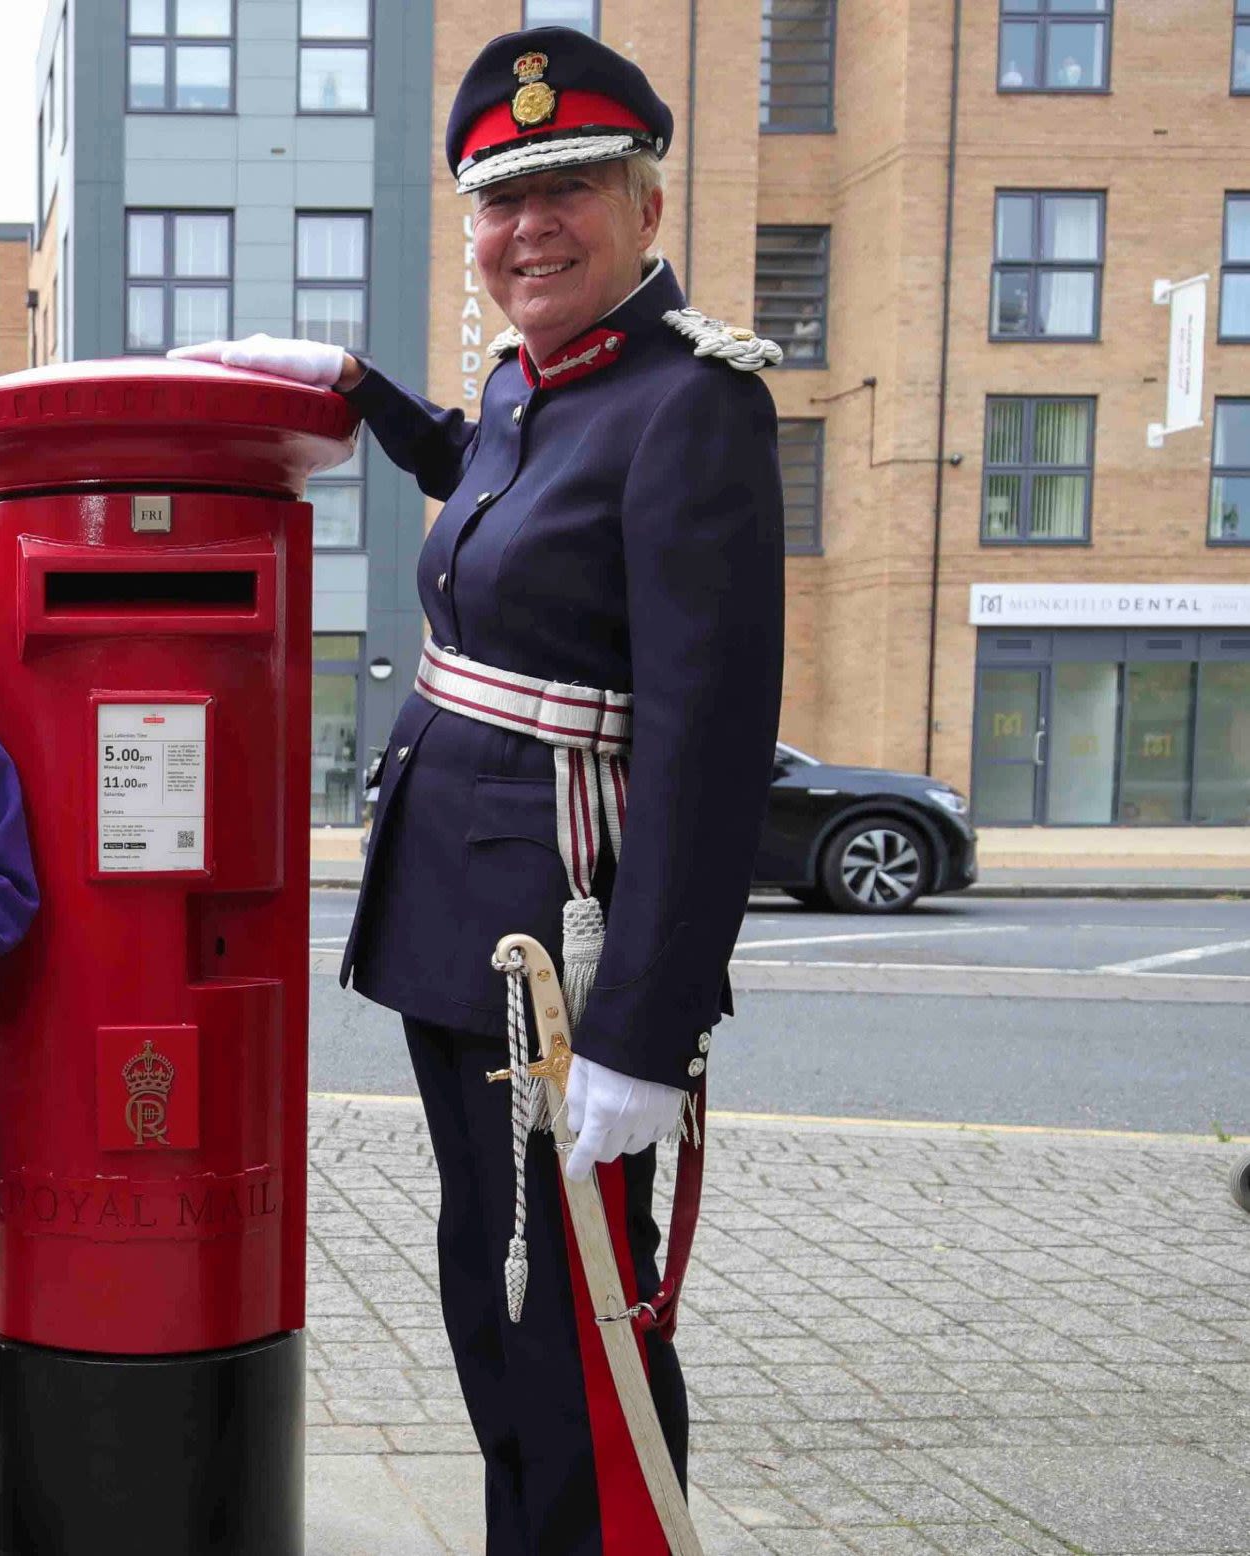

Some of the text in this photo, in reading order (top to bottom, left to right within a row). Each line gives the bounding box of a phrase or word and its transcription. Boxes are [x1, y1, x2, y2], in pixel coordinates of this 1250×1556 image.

[141, 510, 162, 521] FRI
[1118, 597, 1202, 612] DENTAL
[105, 745, 152, 763] 5.00pm
[103, 775, 148, 789] 11.00am
[4, 1180, 277, 1228] ROYAL MAIL
